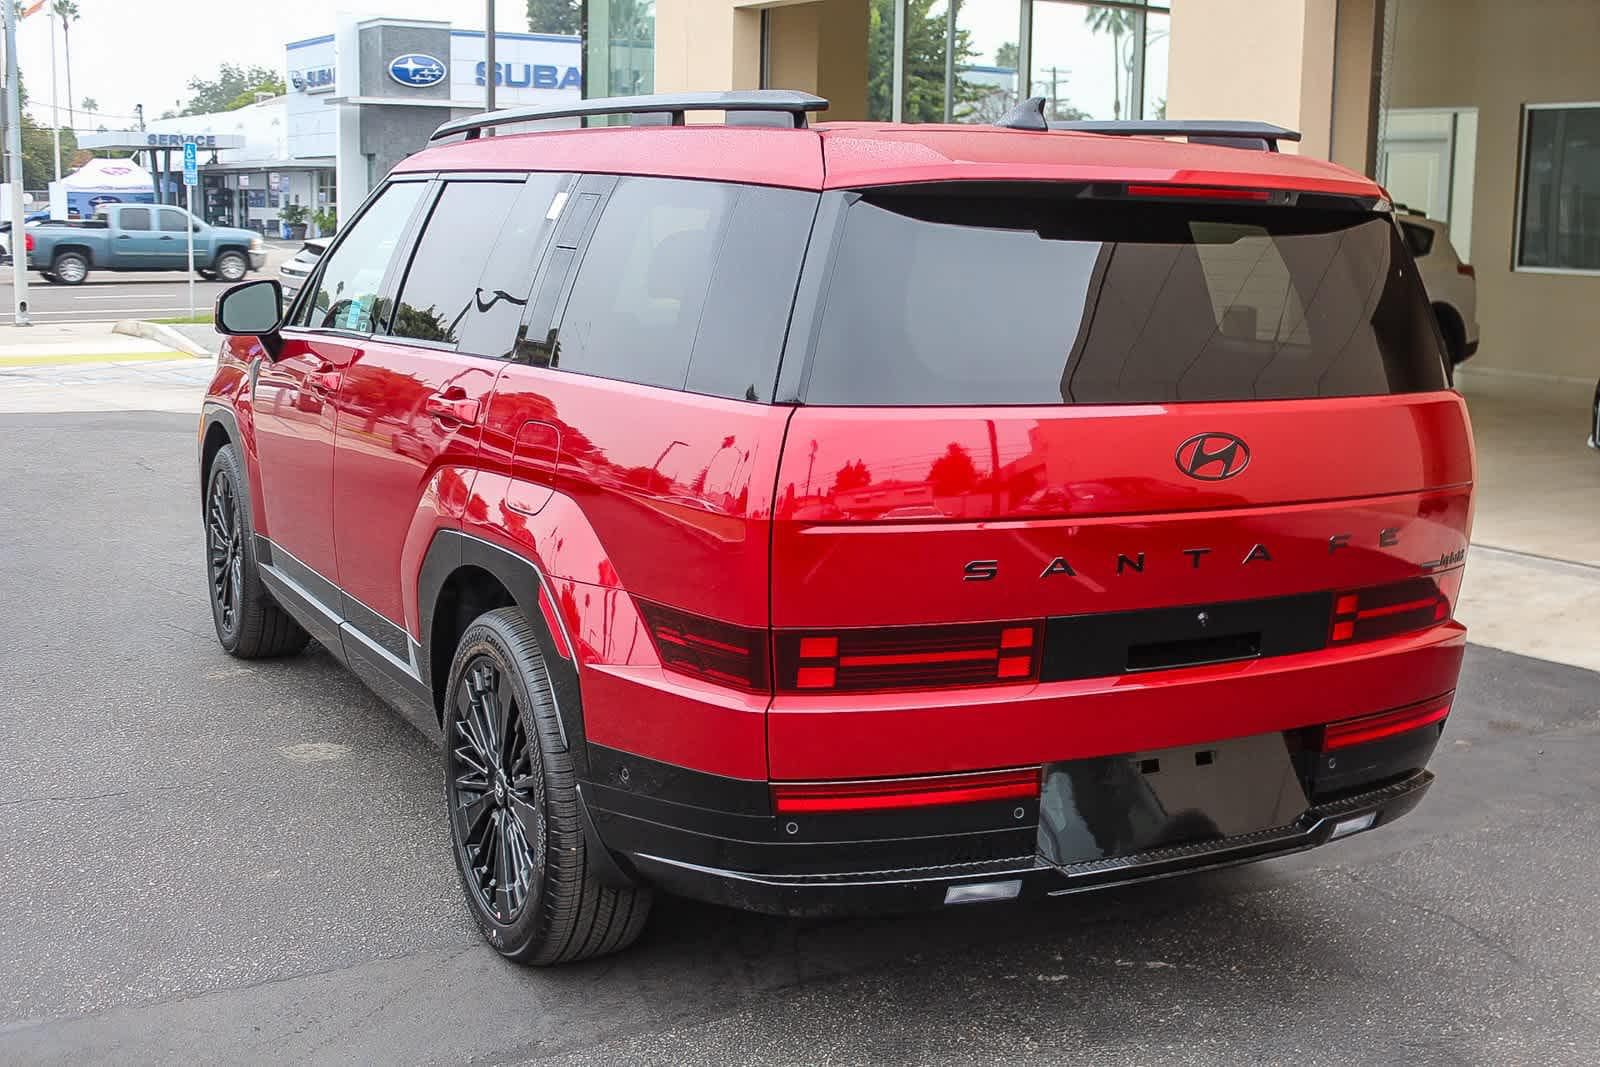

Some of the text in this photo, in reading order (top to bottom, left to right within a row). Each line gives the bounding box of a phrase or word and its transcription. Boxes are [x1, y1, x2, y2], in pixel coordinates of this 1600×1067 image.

[475, 61, 582, 89] SUBA
[147, 134, 216, 146] SERVICE
[963, 527, 1400, 581] SANTA FE
